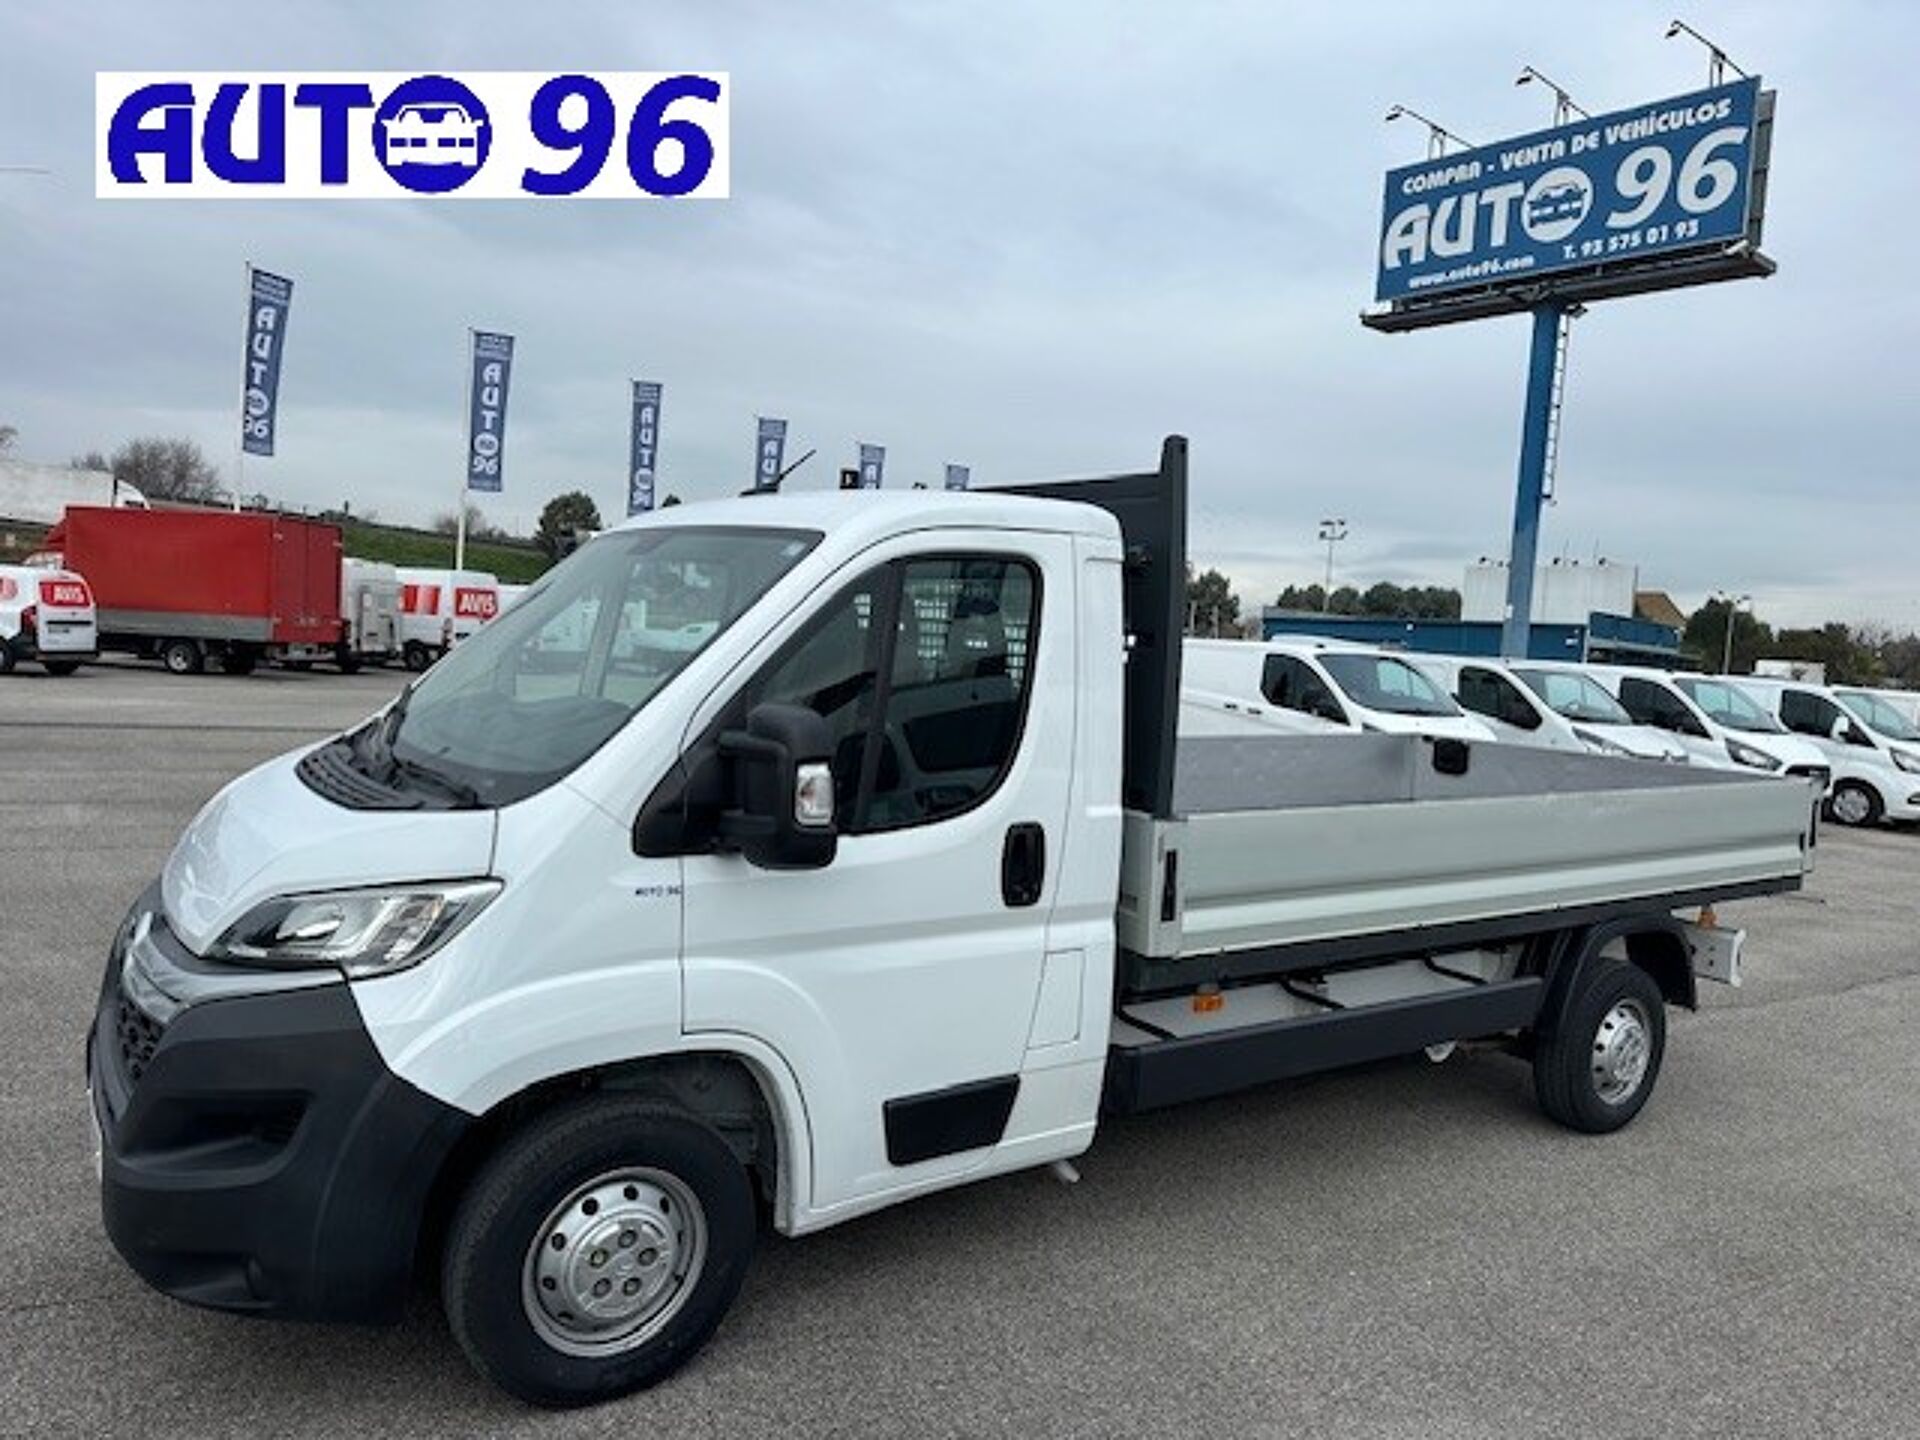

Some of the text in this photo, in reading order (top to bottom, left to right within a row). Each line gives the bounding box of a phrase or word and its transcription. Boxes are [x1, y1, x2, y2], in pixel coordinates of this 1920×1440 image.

[1402, 161, 1481, 195] COMPRA
[1501, 140, 1567, 171] VENTA
[1571, 131, 1601, 153] DE
[1605, 98, 1732, 145] VEHÍCULOS
[1384, 127, 1749, 270] AUTO 96
[1646, 225, 1669, 244] 01
[473, 362, 502, 456] AUTO
[459, 592, 494, 614] AVIS
